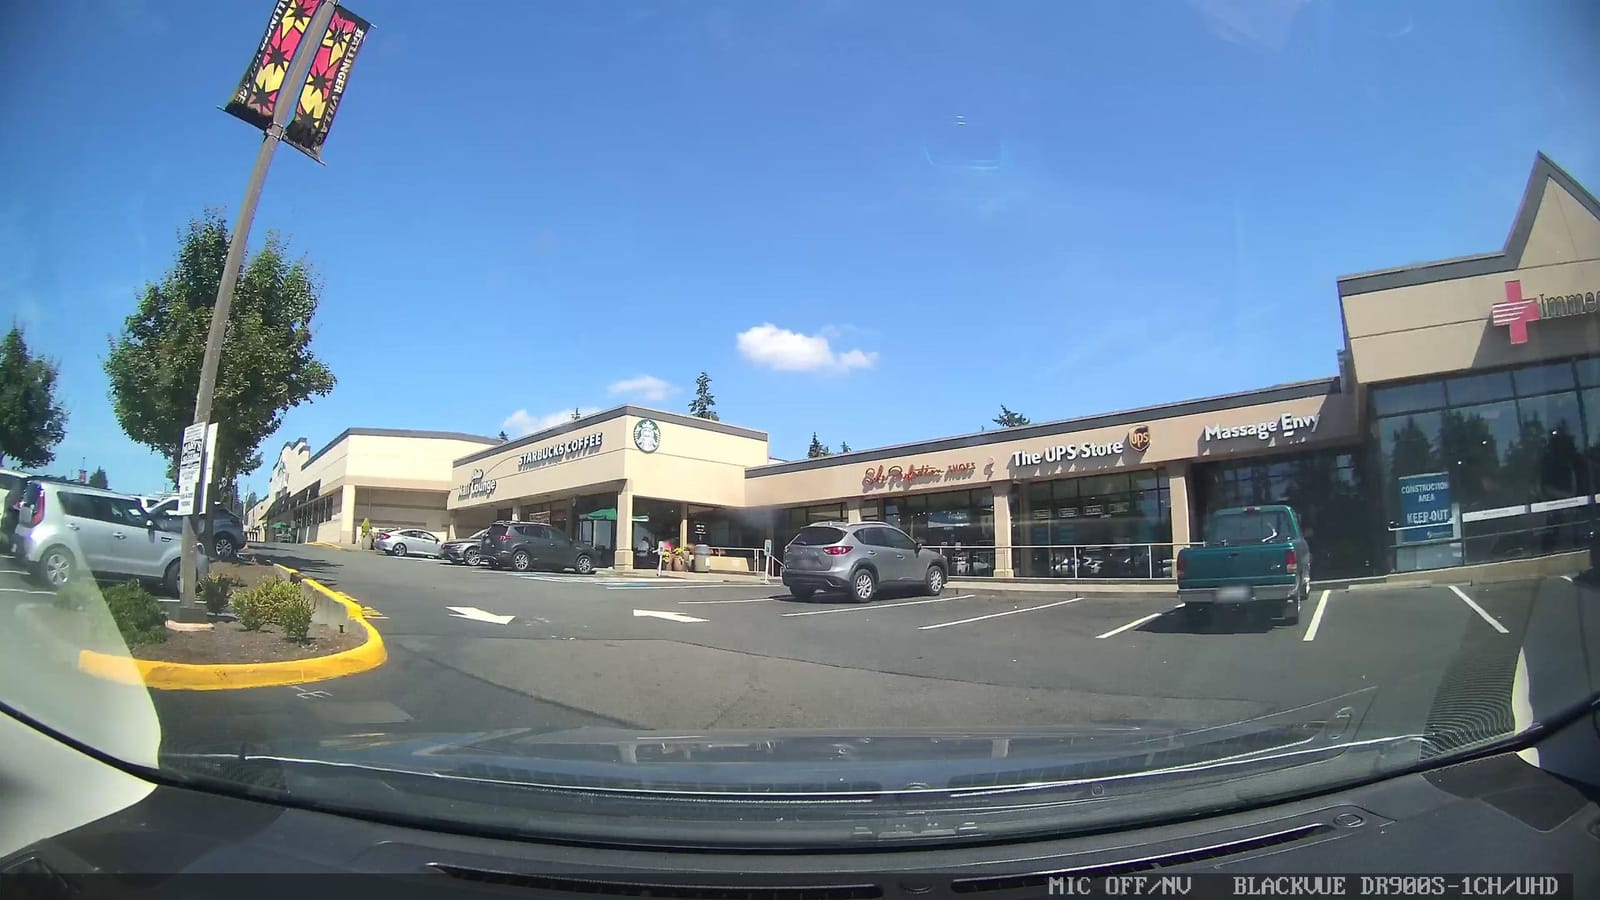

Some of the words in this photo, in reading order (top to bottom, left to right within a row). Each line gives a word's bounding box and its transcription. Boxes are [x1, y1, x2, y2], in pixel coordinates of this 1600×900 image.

[333, 27, 365, 94] BALLINGER
[1204, 420, 1277, 441] Massage
[1281, 412, 1320, 434] Envy
[518, 443, 566, 465] STARBUCKS
[566, 432, 603, 452] COFFEE
[1013, 450, 1042, 467] The
[1045, 444, 1077, 462] UPS
[1081, 441, 1124, 458] Store
[471, 479, 496, 494] Lounge
[1400, 482, 1449, 495] CONSTRUCTION
[1418, 493, 1436, 503] AREA
